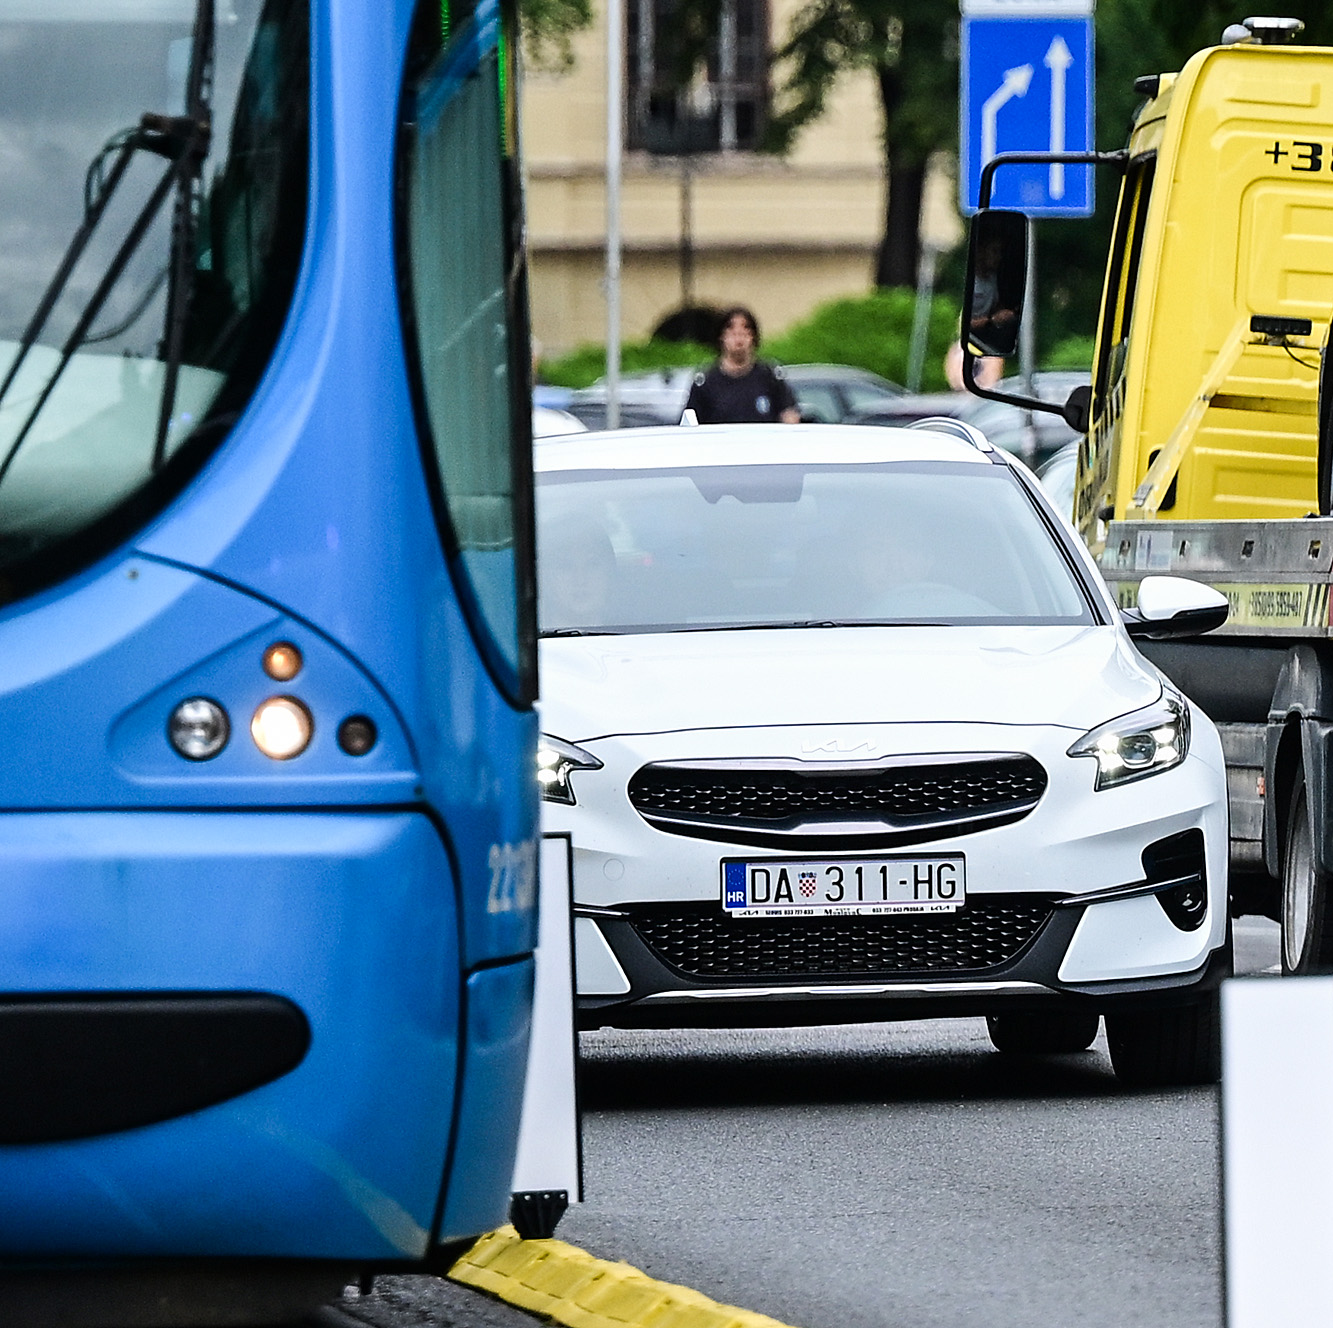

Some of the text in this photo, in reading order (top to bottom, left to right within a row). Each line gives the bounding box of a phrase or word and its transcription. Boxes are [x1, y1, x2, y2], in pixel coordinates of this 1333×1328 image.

[750, 862, 957, 904] DA 311-HG
[727, 891, 745, 903] HR
